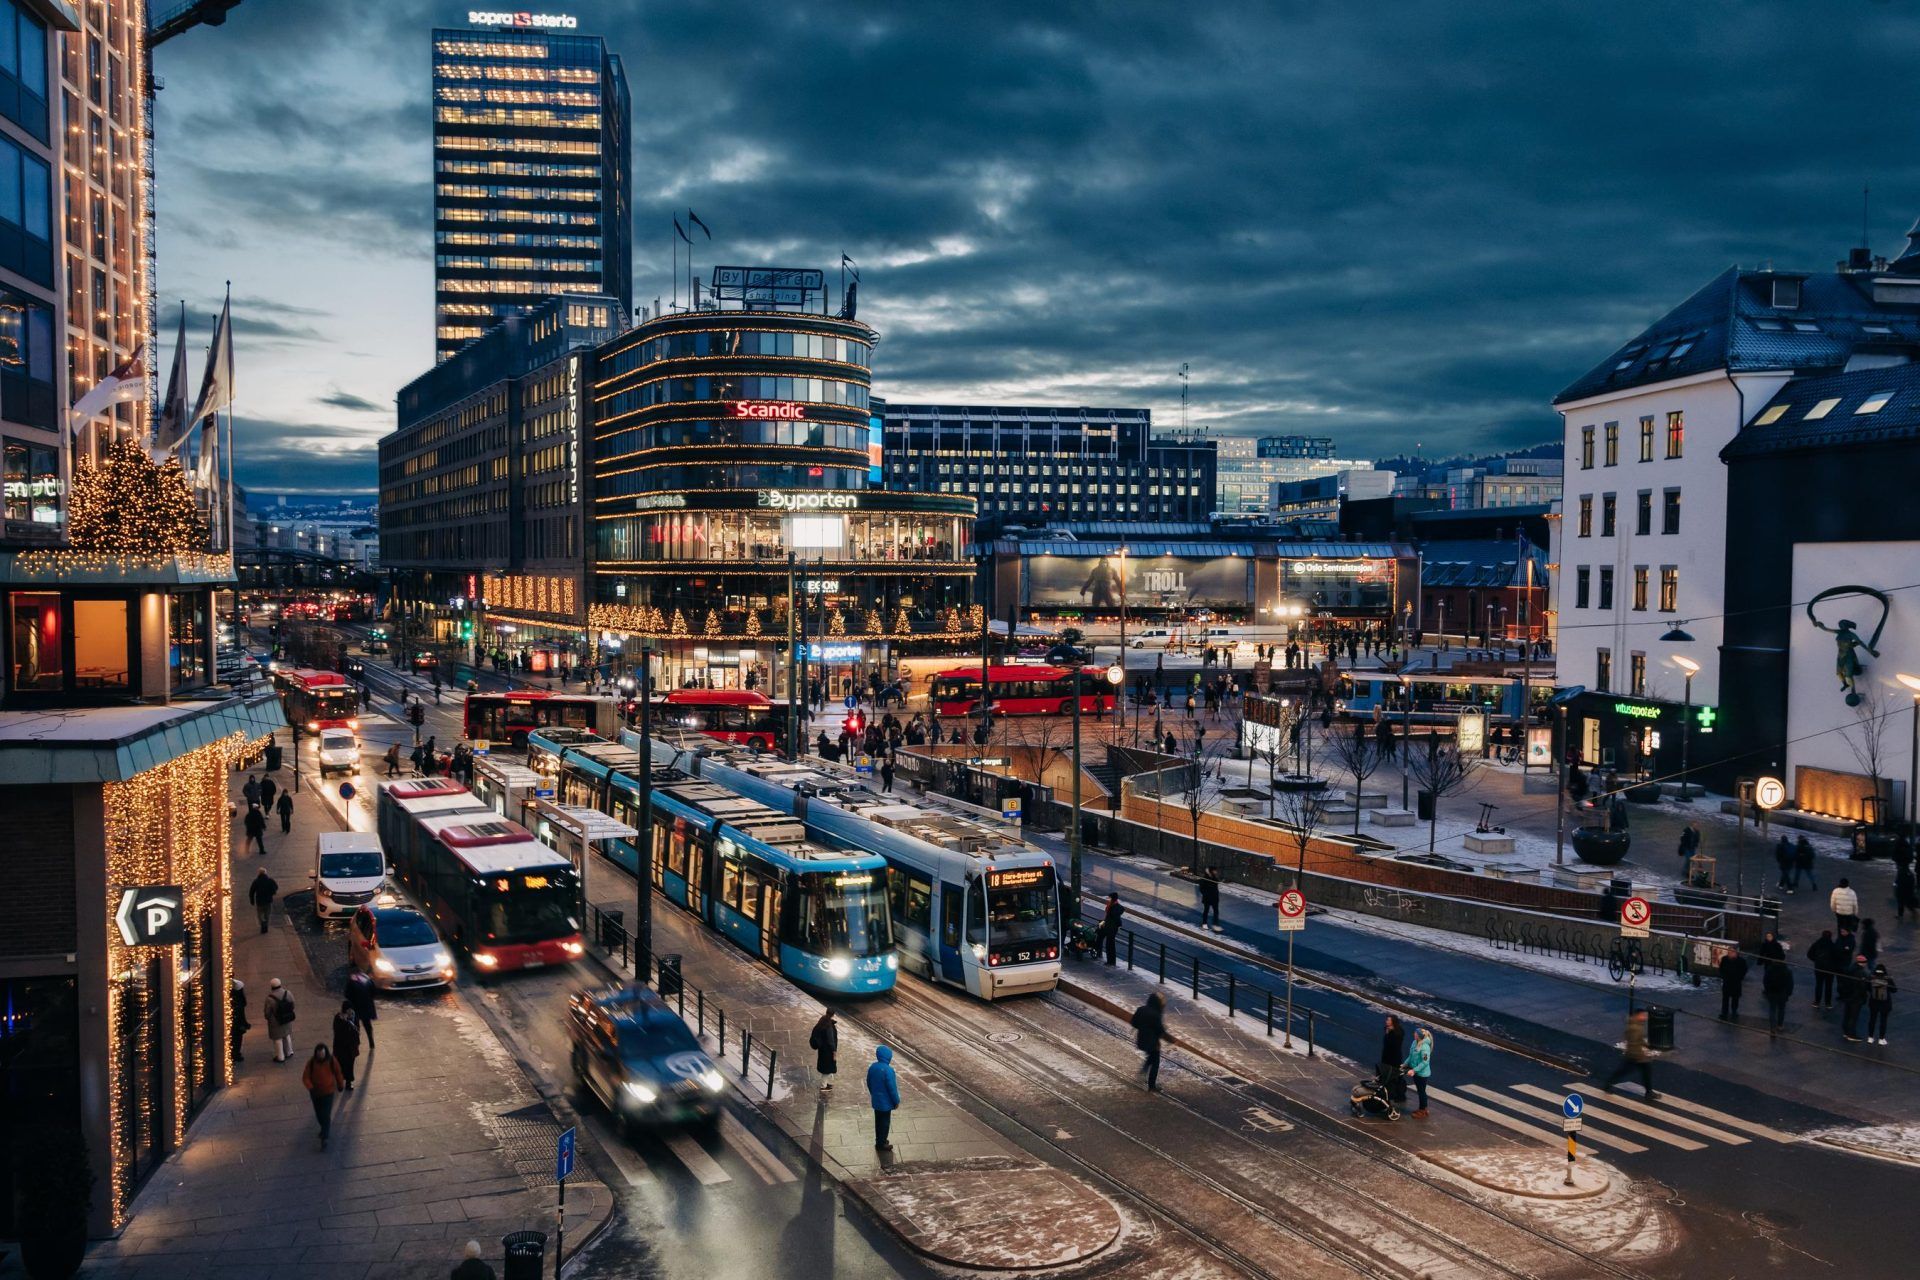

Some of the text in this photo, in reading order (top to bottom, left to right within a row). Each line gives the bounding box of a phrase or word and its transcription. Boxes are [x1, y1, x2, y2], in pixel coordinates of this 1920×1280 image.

[468, 11, 577, 27] sopra steria
[737, 401, 804, 418] Scandic
[770, 490, 857, 510] Byporten
[1306, 563, 1373, 573] Oslo Sentralstasjon
[807, 580, 839, 590] EGON
[1142, 572, 1187, 591] TROLL
[991, 874, 1000, 887] 18
[147, 908, 170, 936] P
[1018, 951, 1030, 961] 152
